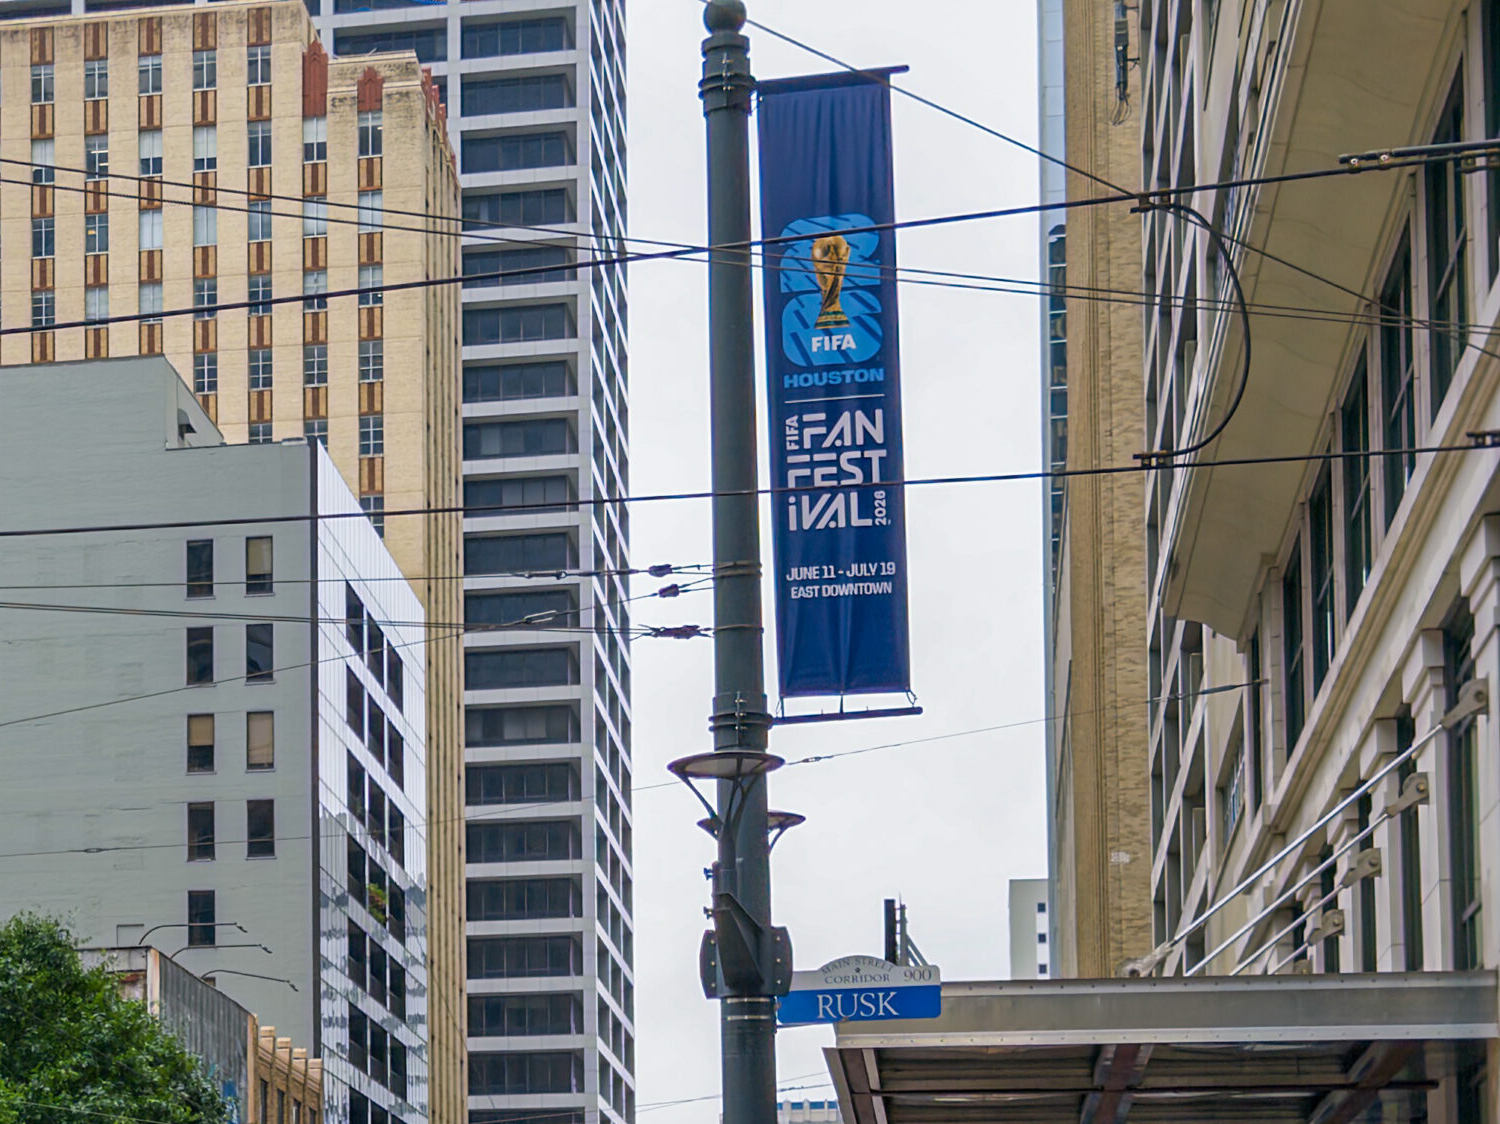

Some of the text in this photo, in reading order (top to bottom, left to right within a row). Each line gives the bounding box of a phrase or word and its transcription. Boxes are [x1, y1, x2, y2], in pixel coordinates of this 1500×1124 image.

[811, 334, 857, 352] FIFA
[783, 368, 885, 389] HOUSTON
[785, 414, 800, 451] FIFA
[802, 408, 885, 450] FAN
[786, 449, 887, 489] FEST
[786, 566, 820, 581] JUNE
[822, 565, 837, 579] 11
[846, 563, 878, 577] JULY
[880, 561, 896, 576] 19
[790, 582, 893, 599] EAST DOWNTOWN
[821, 958, 893, 975] MAIN STREET
[824, 968, 932, 985] CORRIDOR 900
[816, 991, 900, 1019] RUSK
